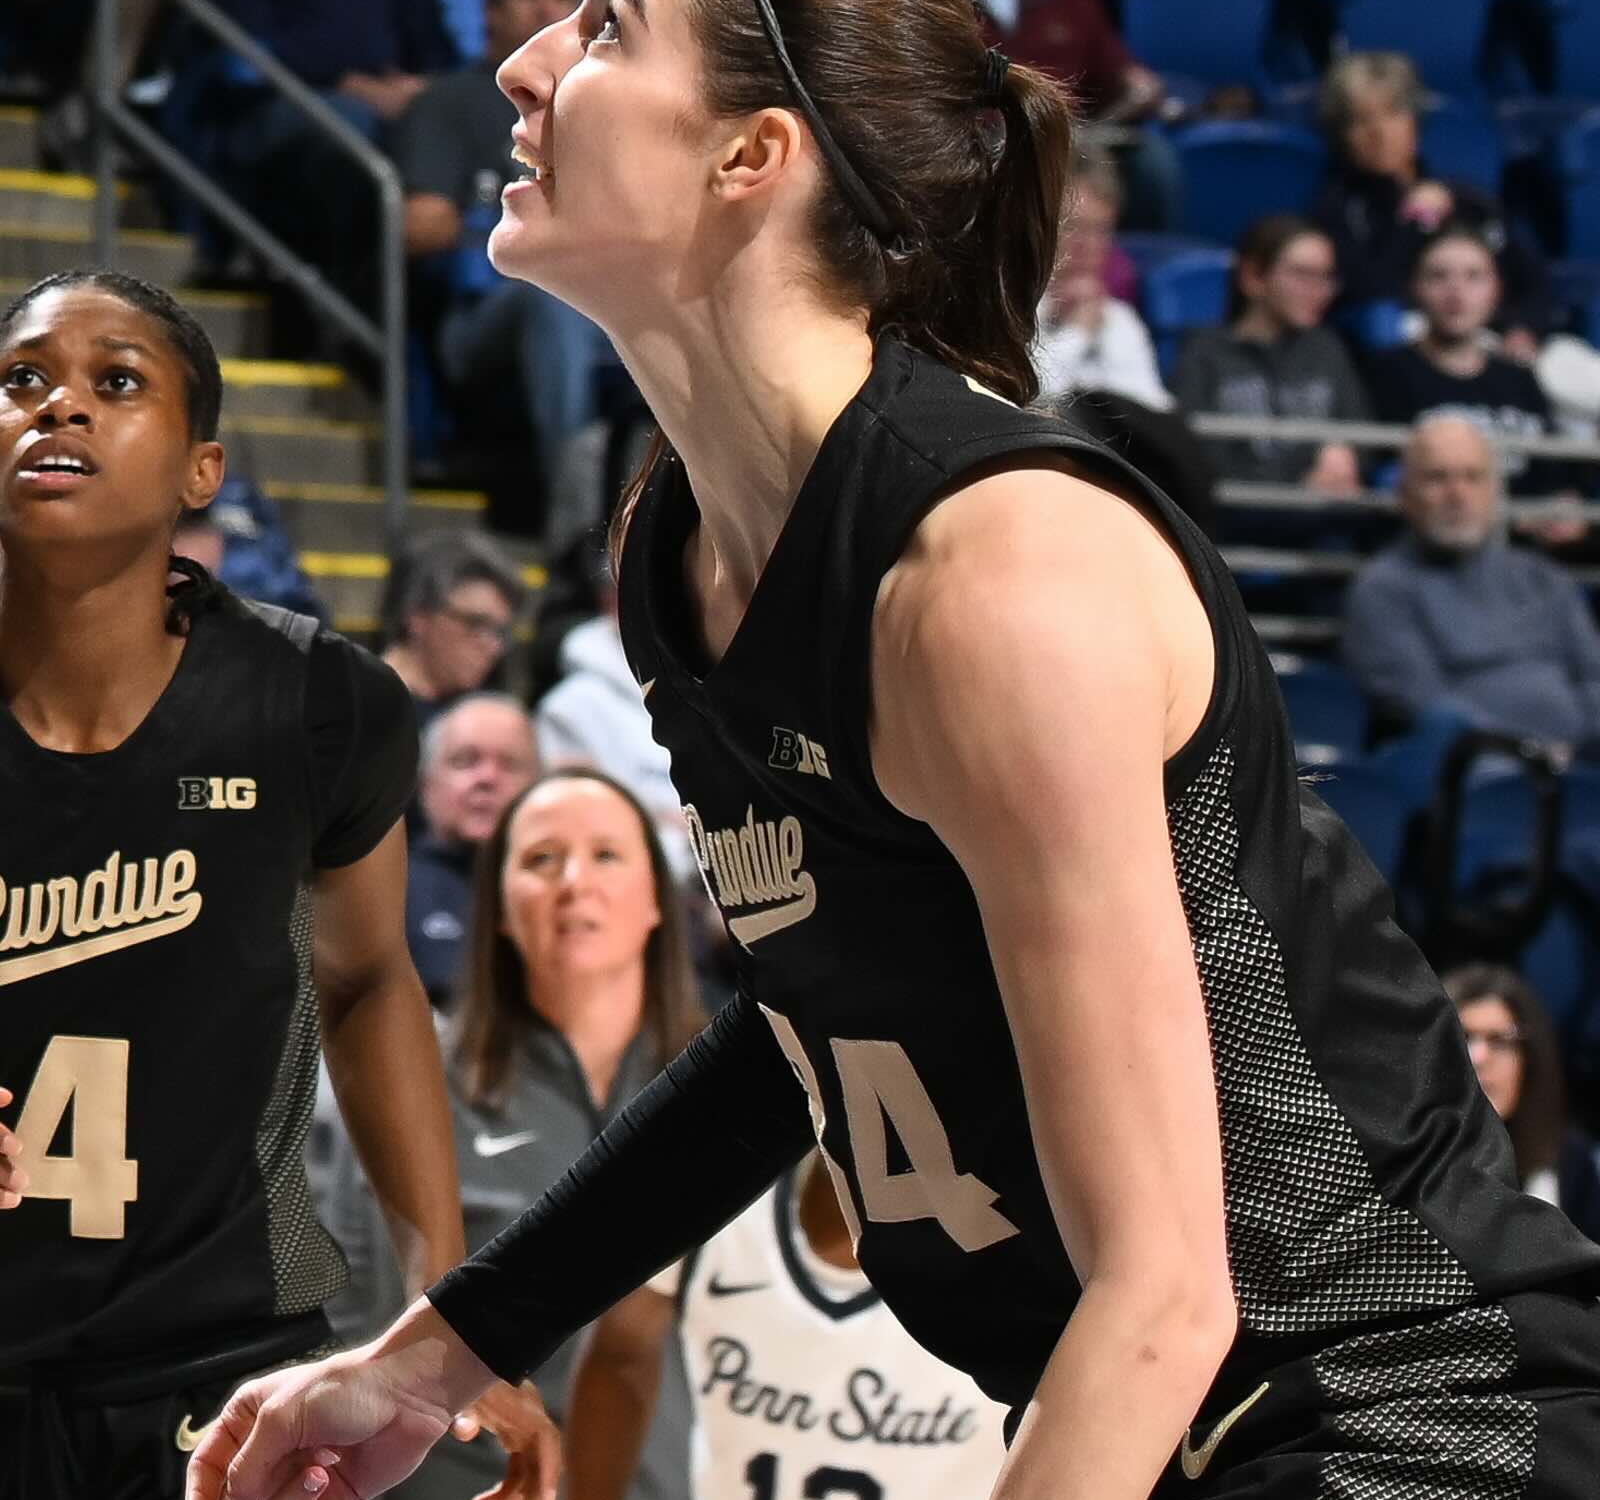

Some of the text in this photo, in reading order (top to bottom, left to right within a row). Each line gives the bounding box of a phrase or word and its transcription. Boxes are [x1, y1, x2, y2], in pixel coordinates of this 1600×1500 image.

[16, 1034, 138, 1239] 4
[702, 1336, 979, 1448] Penn State
